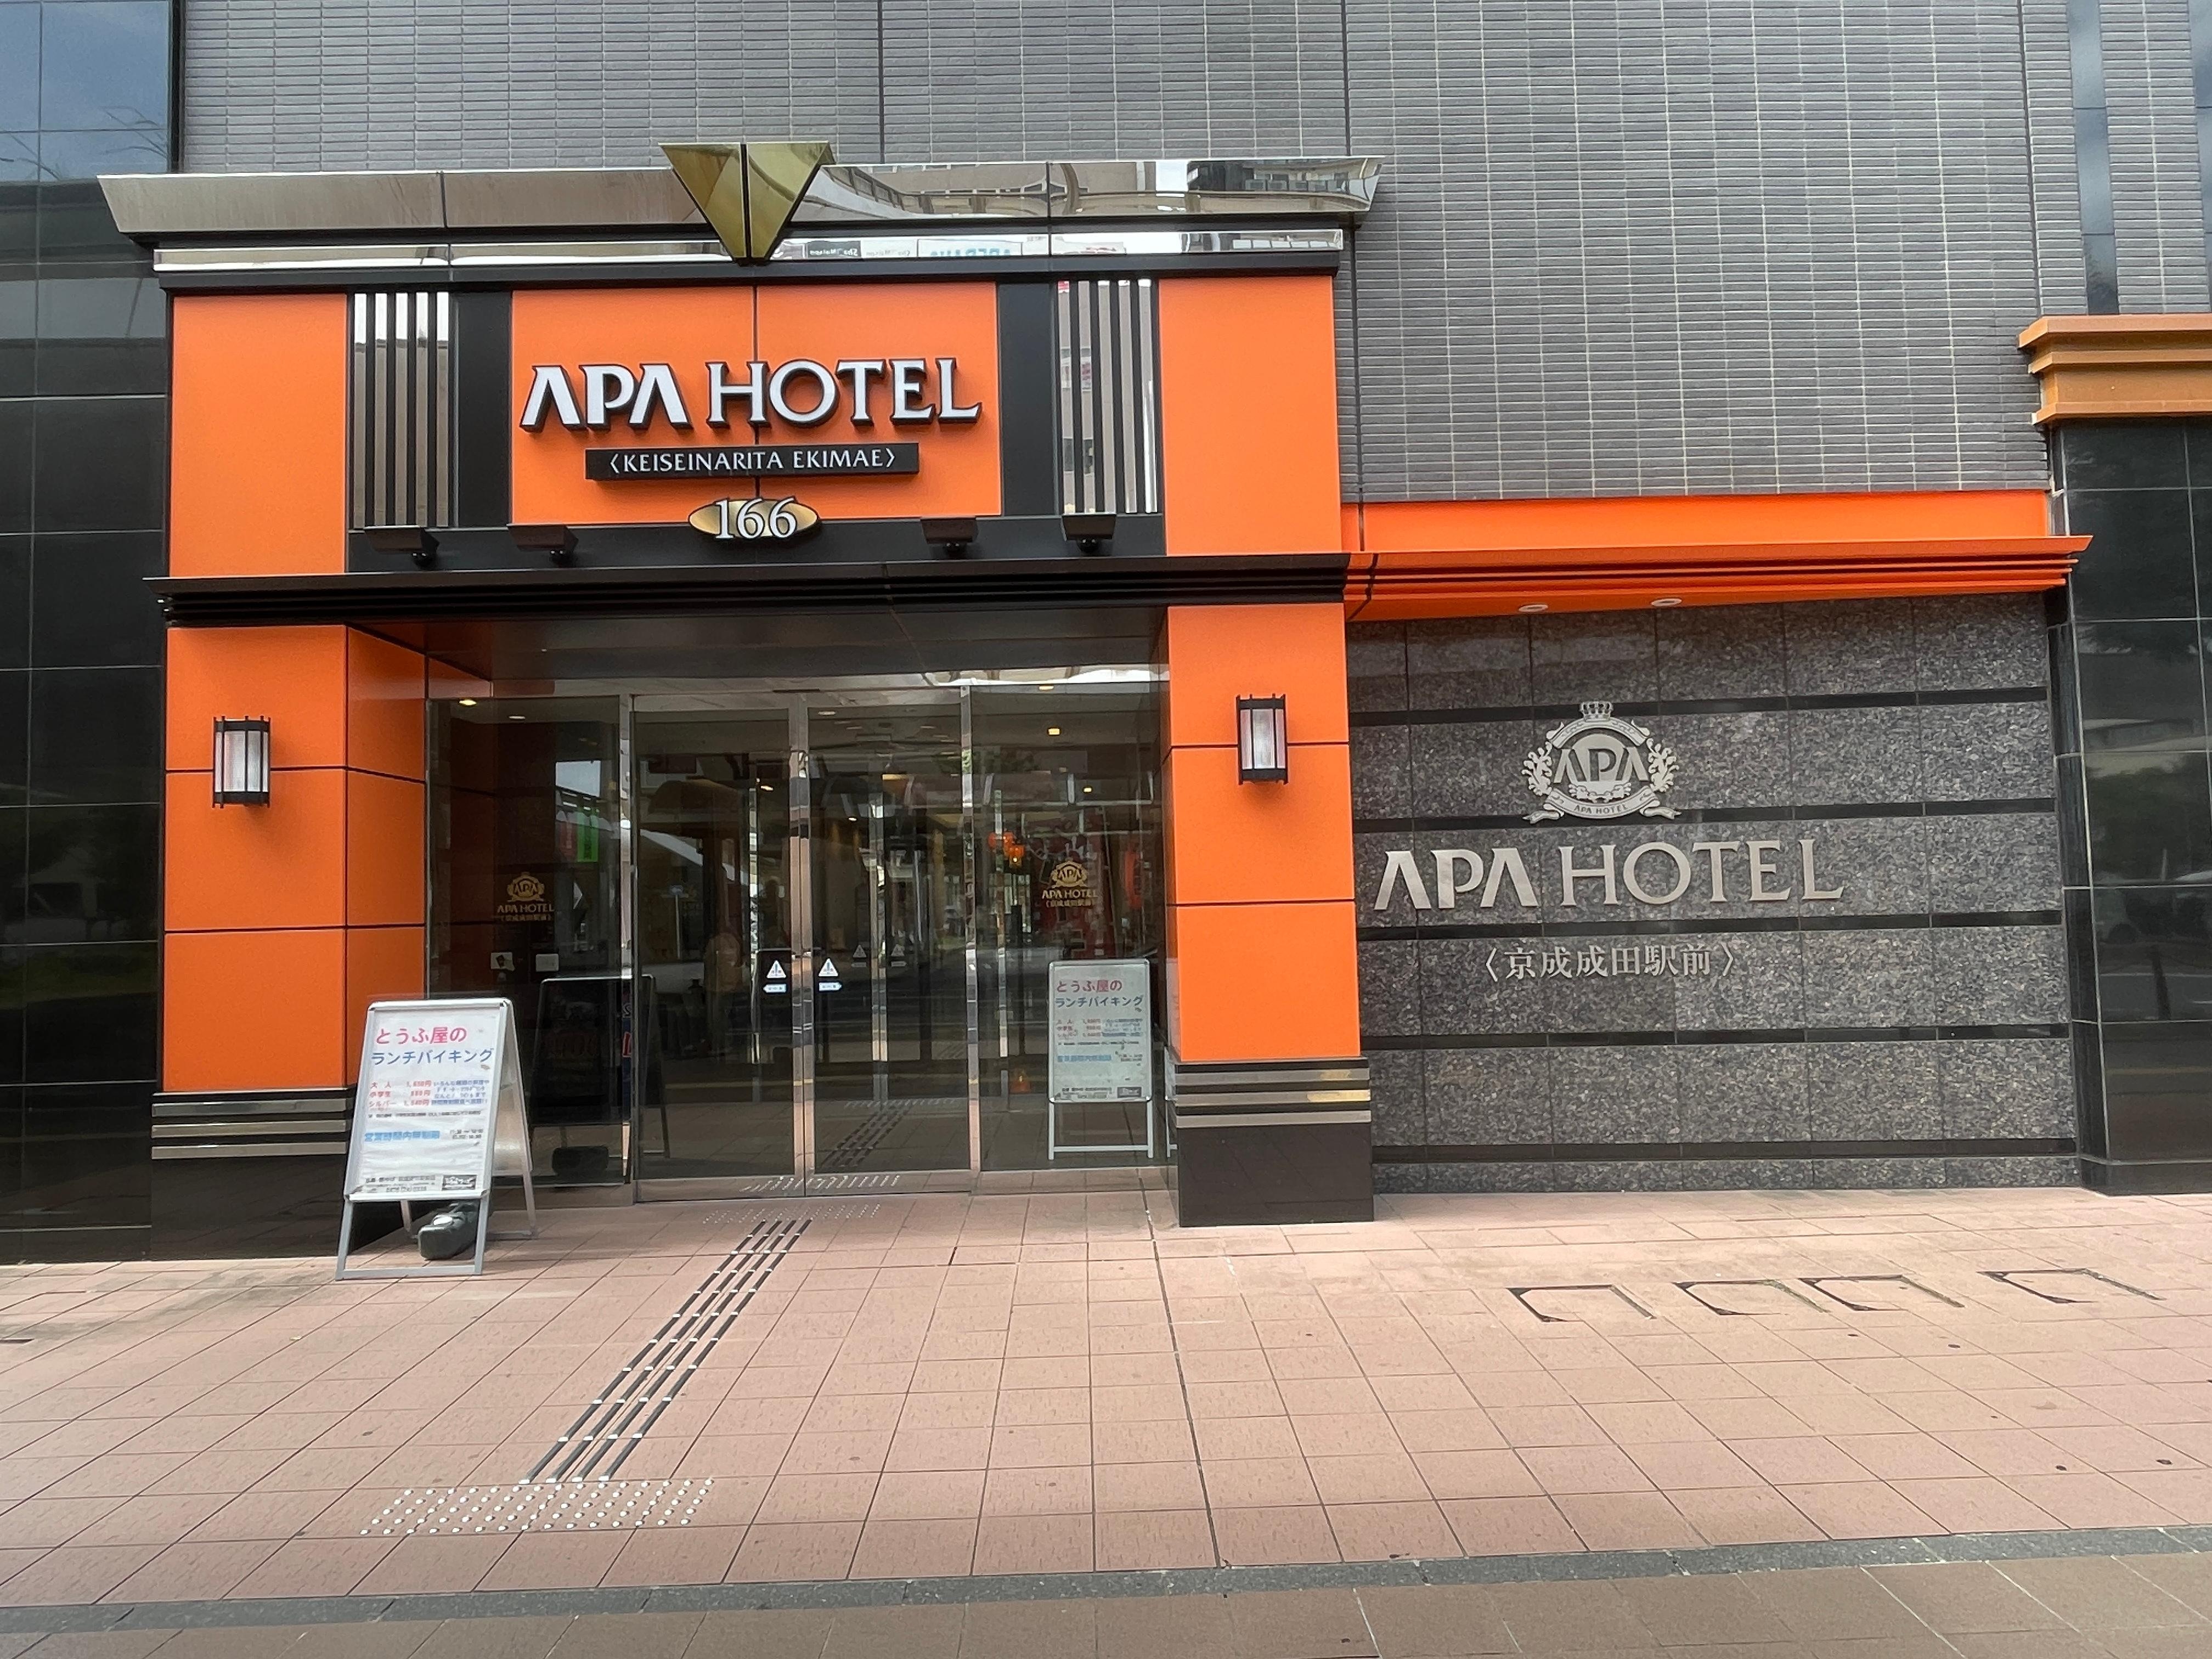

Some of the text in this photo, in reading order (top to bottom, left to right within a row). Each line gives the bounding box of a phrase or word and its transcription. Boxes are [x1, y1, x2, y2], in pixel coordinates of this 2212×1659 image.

[520, 358, 982, 432] APA HOTEL
[714, 496, 798, 540] 166
[1553, 747, 1650, 785] APA
[1573, 802, 1628, 814] APA HOTEL
[1373, 838, 1846, 911] APA HOTEL
[1041, 889, 1098, 899] APA HOTEL
[496, 903, 555, 913] APA HOTEL
[1054, 994, 1144, 1008] ランチバイキング
[376, 1026, 467, 1045] とうふ屋の
[370, 1048, 495, 1065] ランチバイキング
